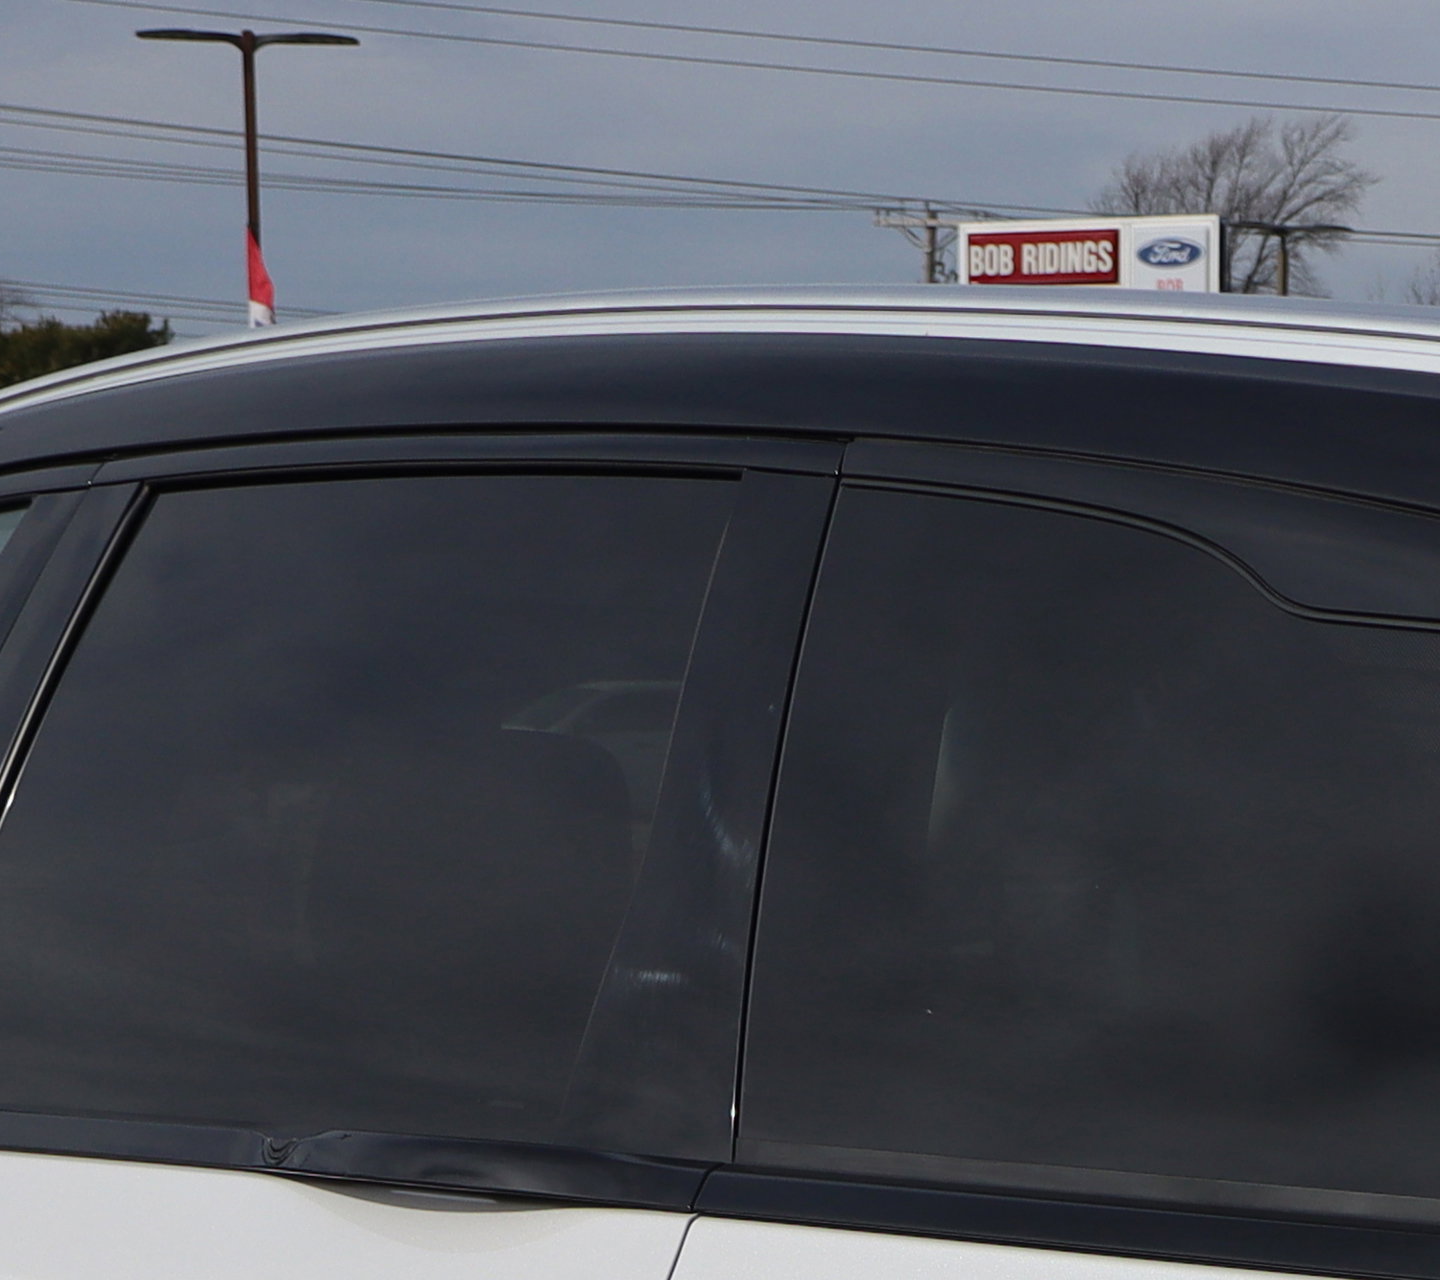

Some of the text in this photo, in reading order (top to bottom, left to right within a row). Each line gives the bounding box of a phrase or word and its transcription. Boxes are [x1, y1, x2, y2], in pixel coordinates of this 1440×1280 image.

[969, 240, 1113, 277] BOB RIDINGS
[1148, 240, 1191, 263] Ford
